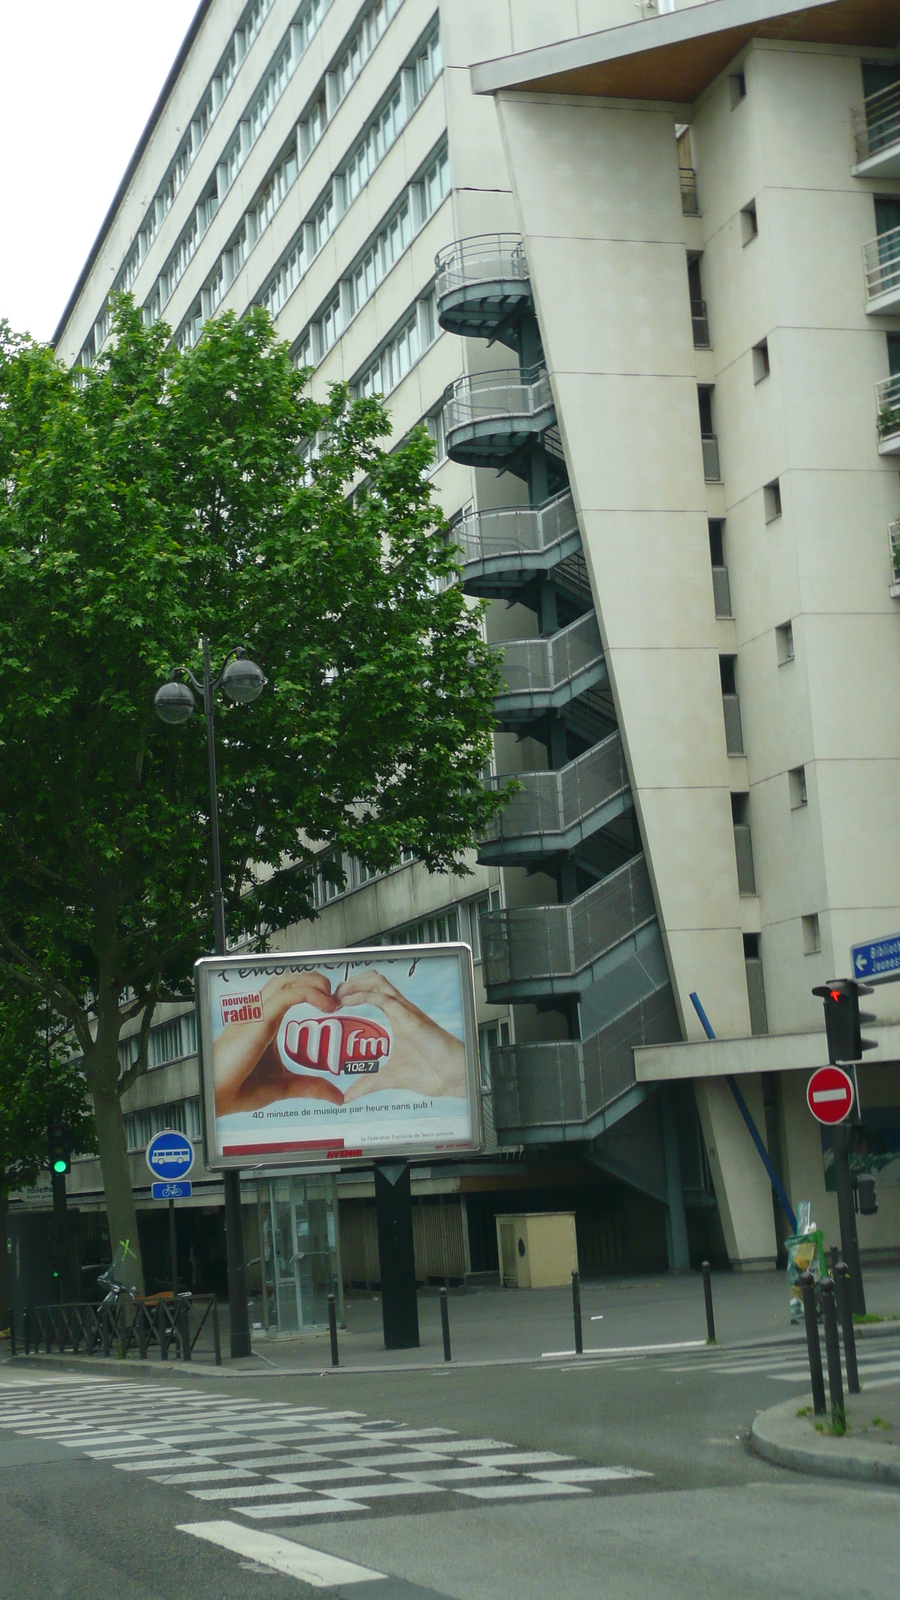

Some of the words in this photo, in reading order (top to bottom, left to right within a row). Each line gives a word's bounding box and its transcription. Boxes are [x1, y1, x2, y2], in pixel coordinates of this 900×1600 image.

[222, 994, 260, 1007] nouvelle
[223, 1005, 262, 1023] radio
[345, 1062, 375, 1073] 102.7
[252, 1111, 264, 1120] 40
[266, 1110, 299, 1118] minutes
[301, 1108, 311, 1117] de
[314, 1106, 347, 1117] musique
[349, 1106, 363, 1115] par
[366, 1104, 389, 1112] heure
[391, 1102, 411, 1110] sans
[413, 1100, 428, 1111] pub
[326, 1149, 362, 1159] AVENIR
